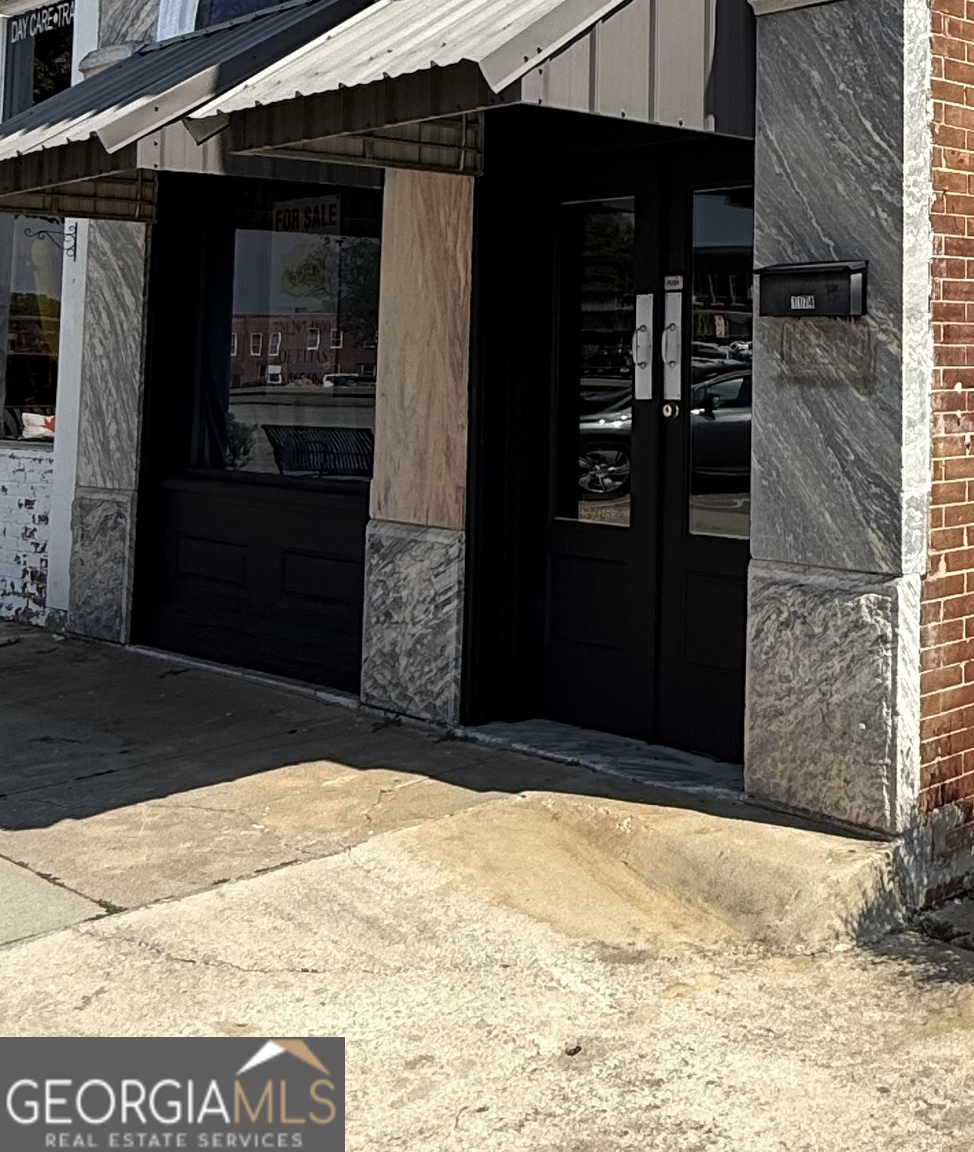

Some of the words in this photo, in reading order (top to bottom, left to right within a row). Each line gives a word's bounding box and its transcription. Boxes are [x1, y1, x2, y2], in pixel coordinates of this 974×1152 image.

[11, 15, 29, 43] DAY
[275, 208, 300, 231] FOR
[303, 203, 337, 230] SALE
